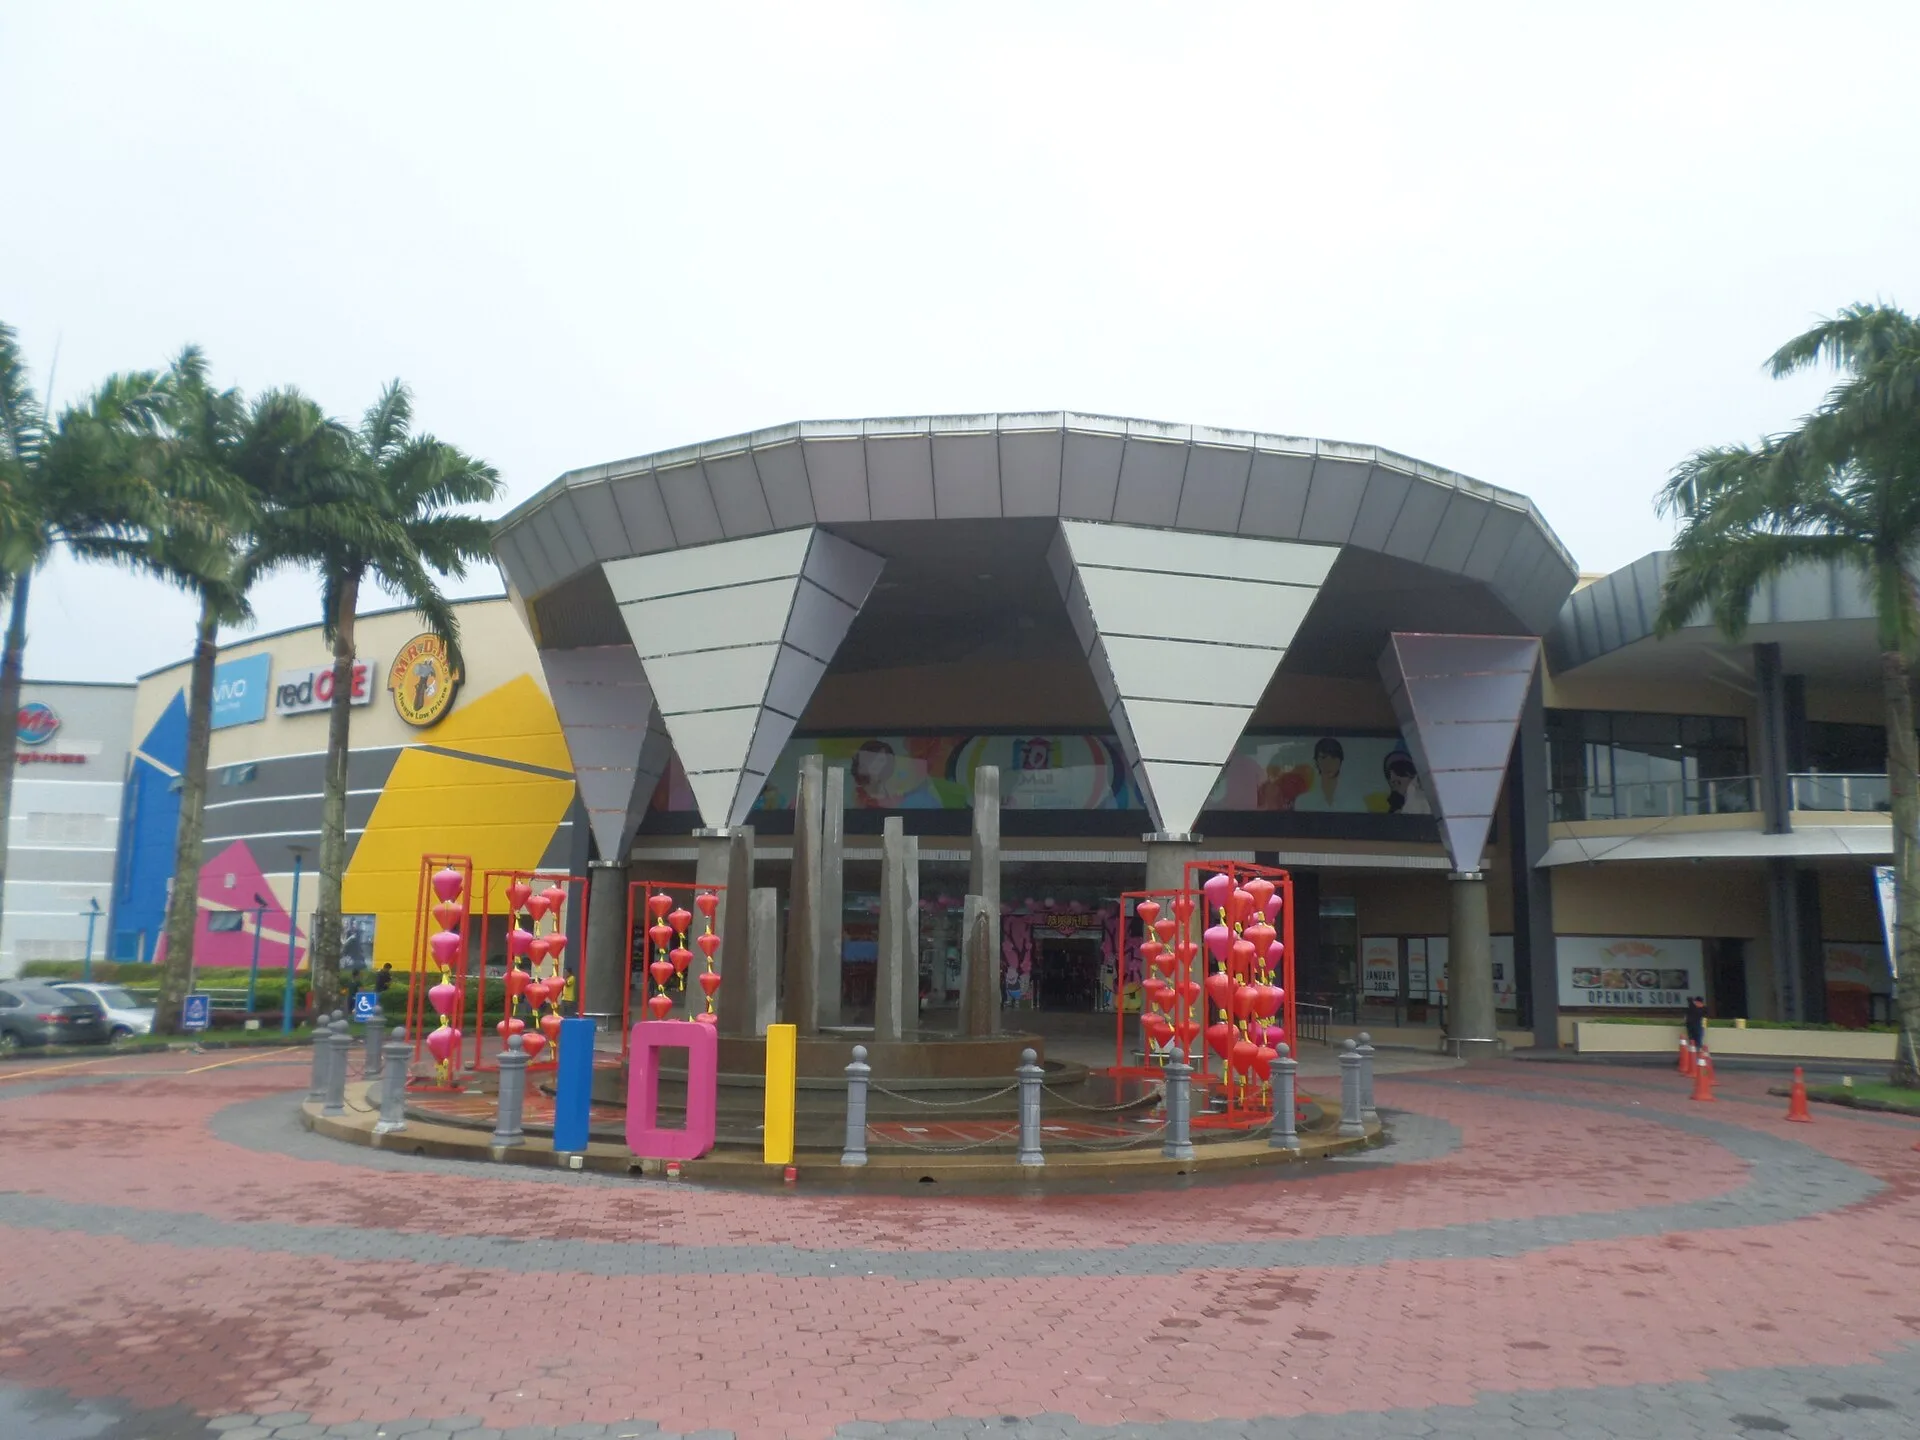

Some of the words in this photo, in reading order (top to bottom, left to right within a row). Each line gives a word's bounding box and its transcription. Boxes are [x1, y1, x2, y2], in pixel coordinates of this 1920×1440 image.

[276, 665, 368, 708] redOE
[397, 691, 415, 719] Always
[415, 711, 431, 721] Low
[430, 687, 448, 713] Prices
[1365, 970, 1396, 981] JANUARY
[1587, 990, 1643, 1004] OPENING
[1650, 991, 1682, 1005] SOON
